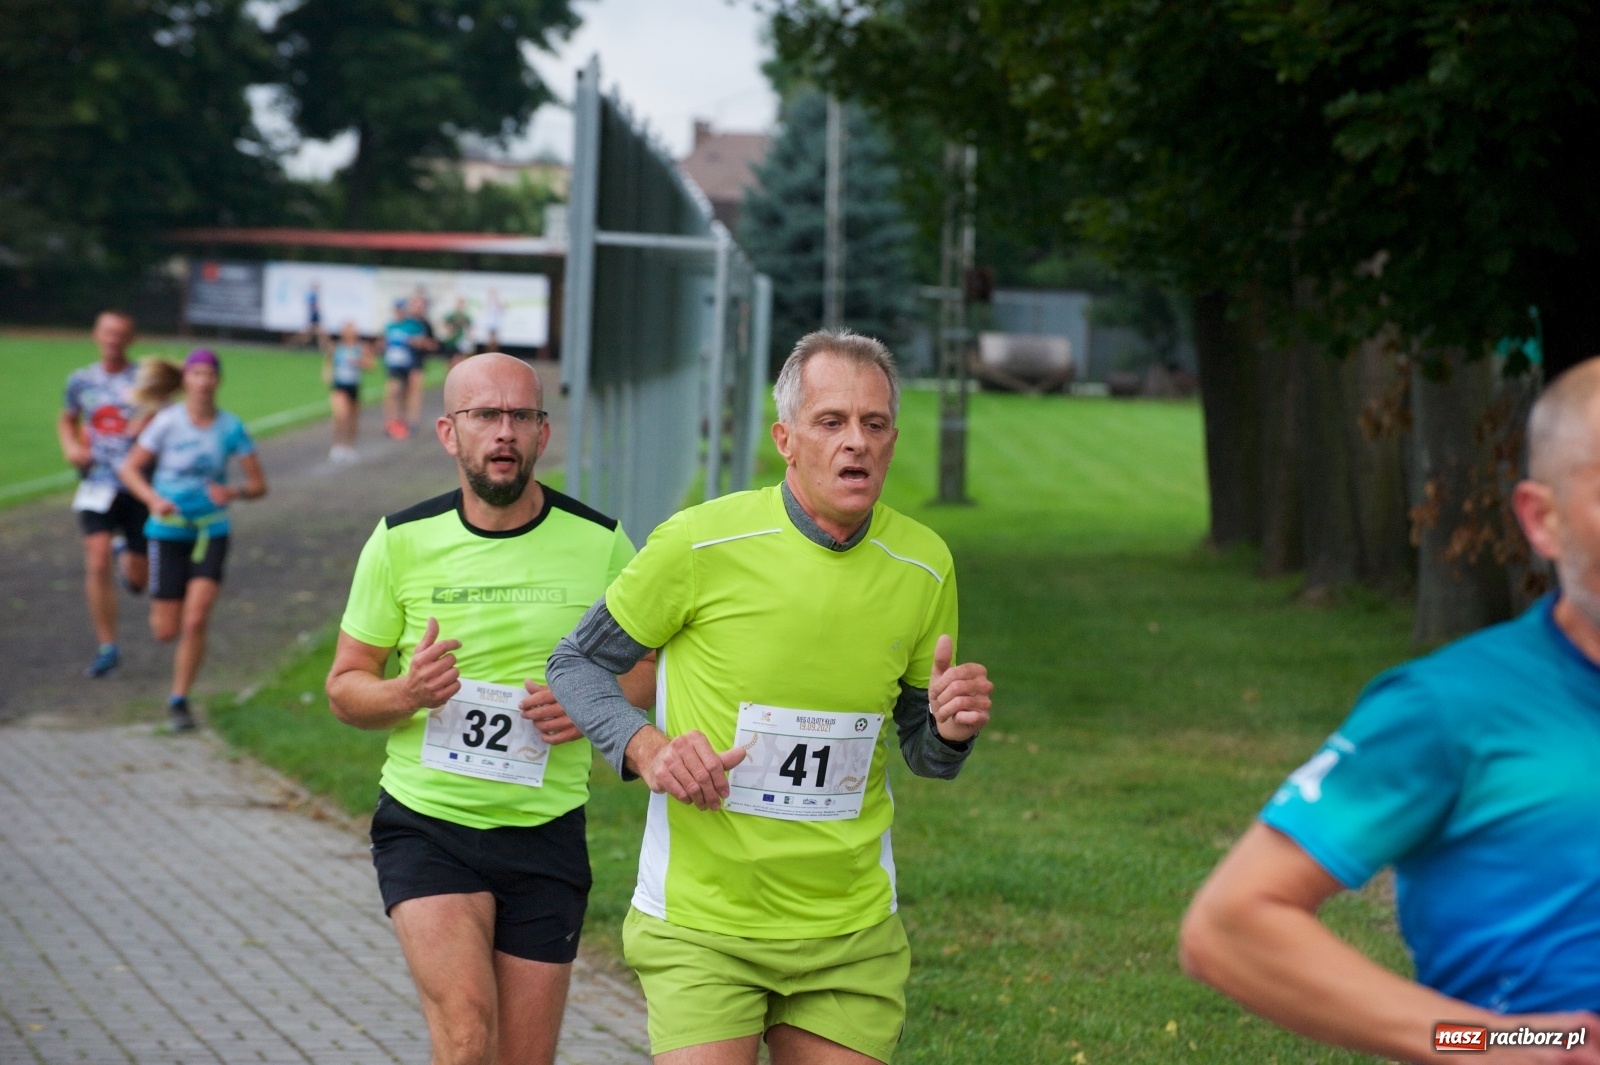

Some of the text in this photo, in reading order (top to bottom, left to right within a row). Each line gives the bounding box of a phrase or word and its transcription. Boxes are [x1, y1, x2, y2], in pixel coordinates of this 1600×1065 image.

[435, 588, 563, 602] 4F RUNNING
[462, 709, 512, 752] 32
[799, 722, 831, 732] 19.09.2021
[779, 743, 831, 788] 41
